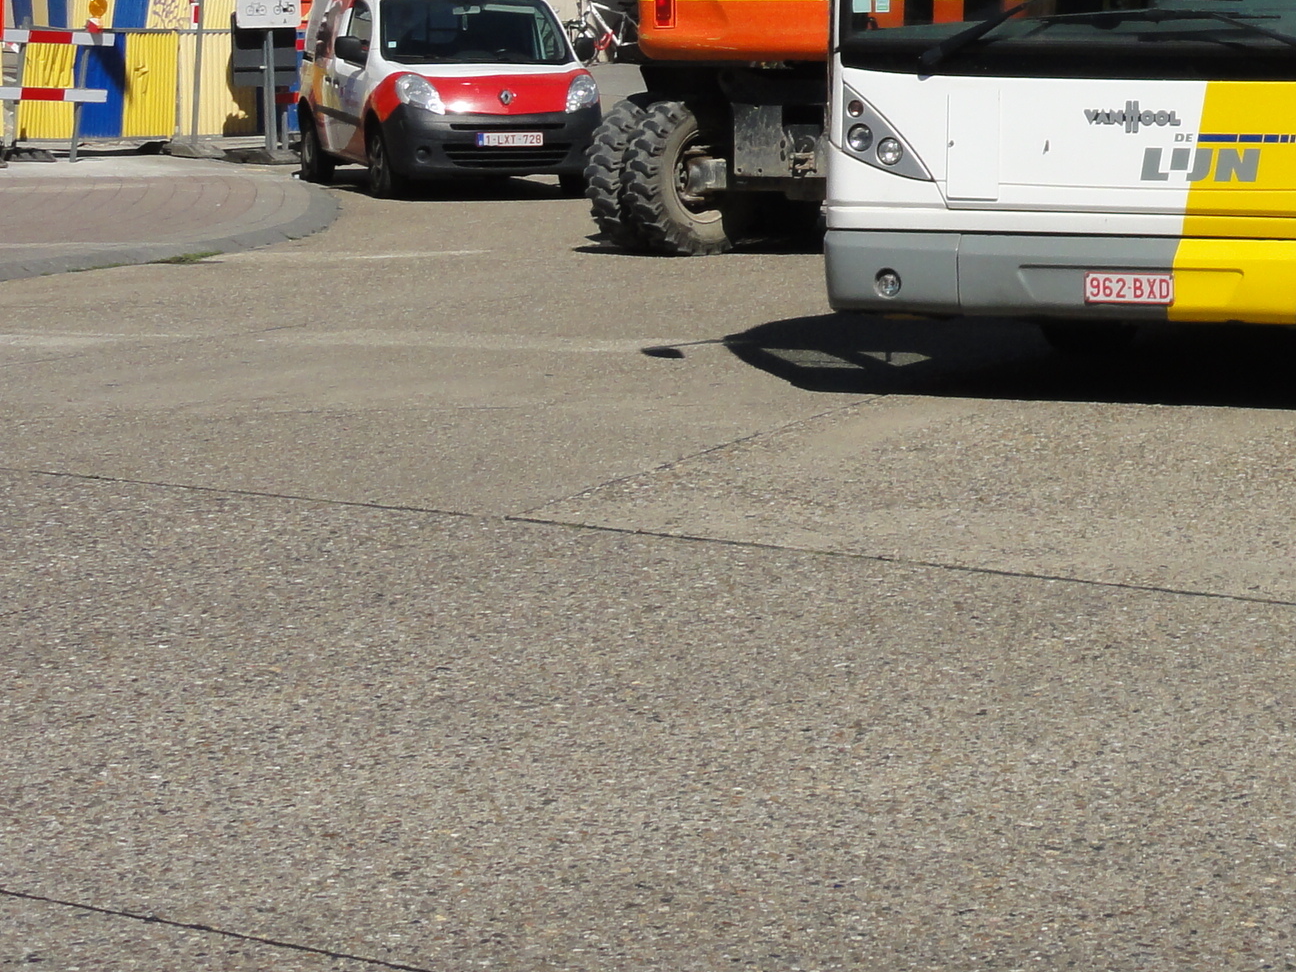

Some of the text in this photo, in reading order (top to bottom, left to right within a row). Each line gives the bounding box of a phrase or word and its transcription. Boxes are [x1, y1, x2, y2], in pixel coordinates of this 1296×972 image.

[1174, 133, 1194, 142] DE
[1140, 147, 1261, 182] LIJN
[1089, 276, 1170, 299] 962-BXD
